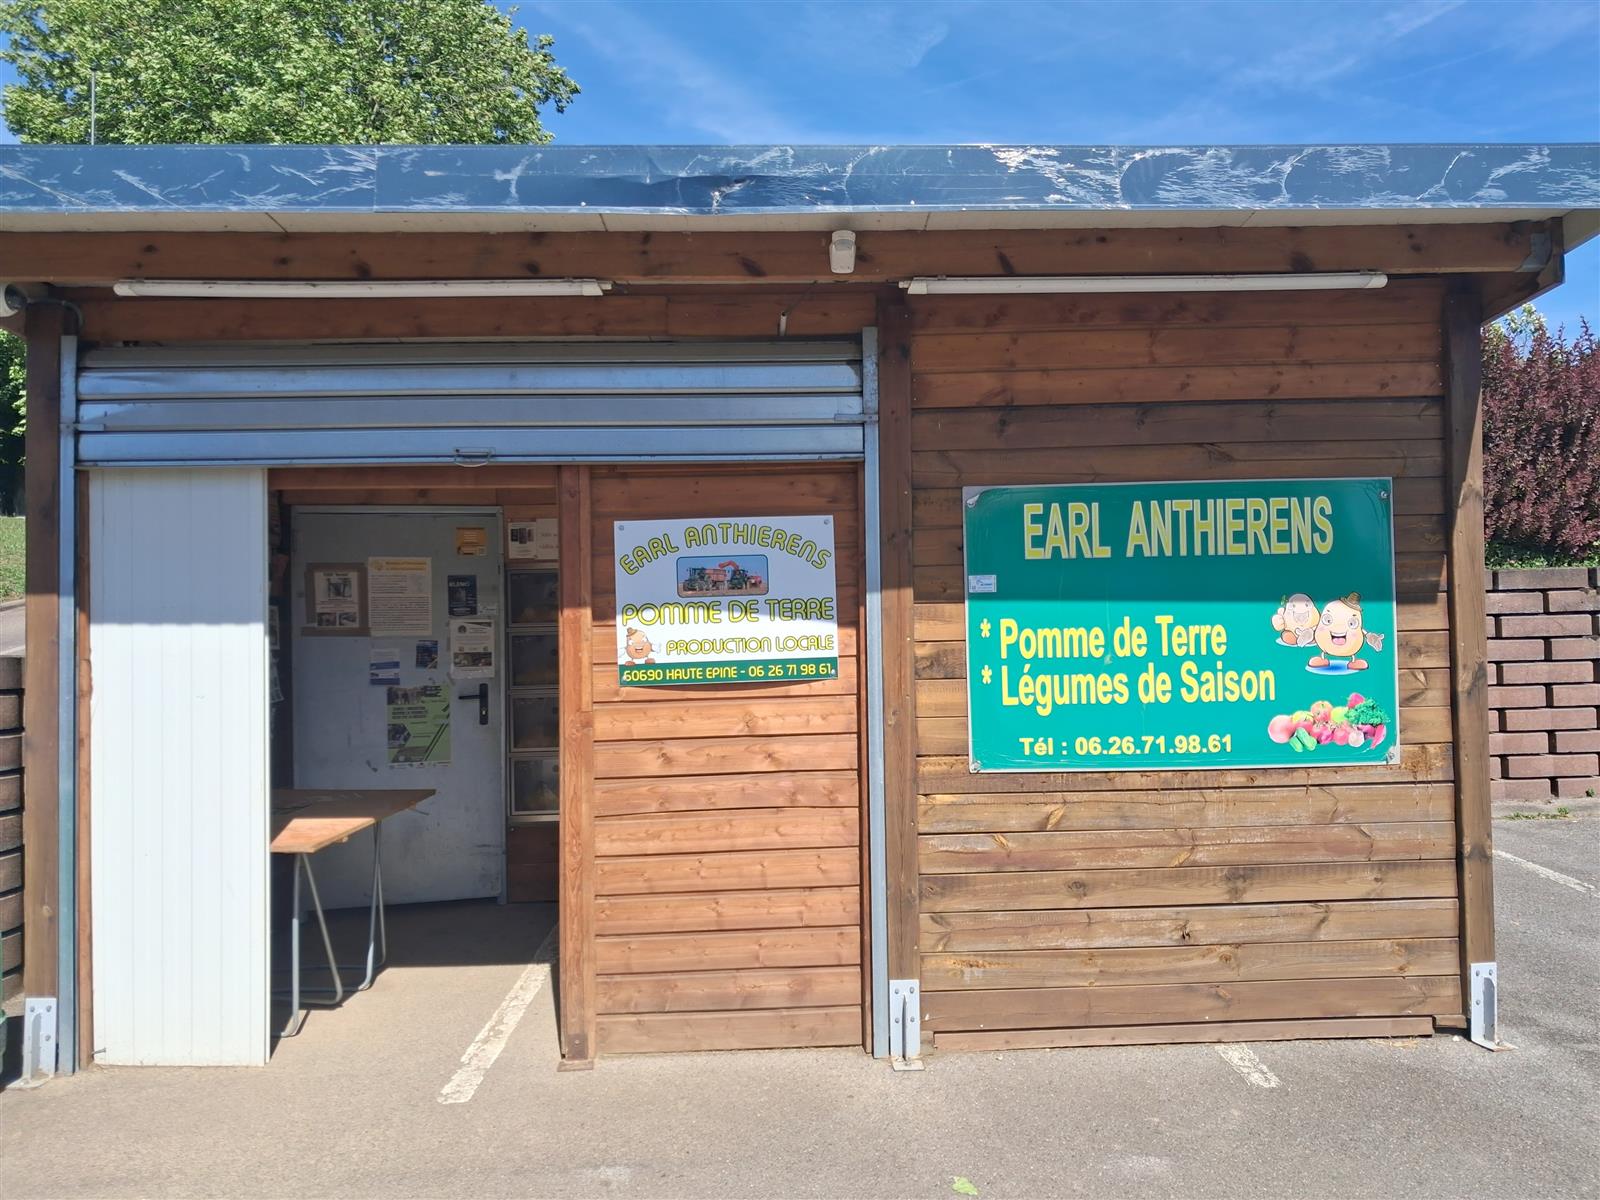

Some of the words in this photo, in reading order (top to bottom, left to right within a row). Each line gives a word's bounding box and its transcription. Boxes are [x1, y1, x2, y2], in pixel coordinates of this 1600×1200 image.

[1024, 502, 1111, 560] EARL
[1126, 496, 1333, 557] ANTHIERENS
[620, 534, 679, 575] EARL
[684, 523, 832, 569] ANTHIERENS
[622, 601, 721, 626] POMME
[728, 600, 759, 623] DE
[766, 598, 833, 621] TERRE
[666, 637, 771, 656] PRODUCTION
[775, 635, 833, 651] LOCALE
[1000, 619, 1105, 659] Pomme
[1114, 616, 1147, 657] de
[1155, 615, 1227, 656] Terre
[624, 670, 662, 682] 60690
[666, 668, 702, 680] HAUTE
[706, 667, 737, 678] EPINE
[749, 666, 763, 676] 06
[768, 665, 783, 676] 26
[787, 665, 796, 675] 71
[800, 664, 816, 675] 98
[819, 663, 832, 674] 61
[1001, 665, 1128, 717] Légumes
[1138, 663, 1171, 703] de
[1180, 661, 1275, 702] Saison
[1019, 736, 1053, 756] Tél
[1075, 734, 1232, 755] 06.26.71.98.61
